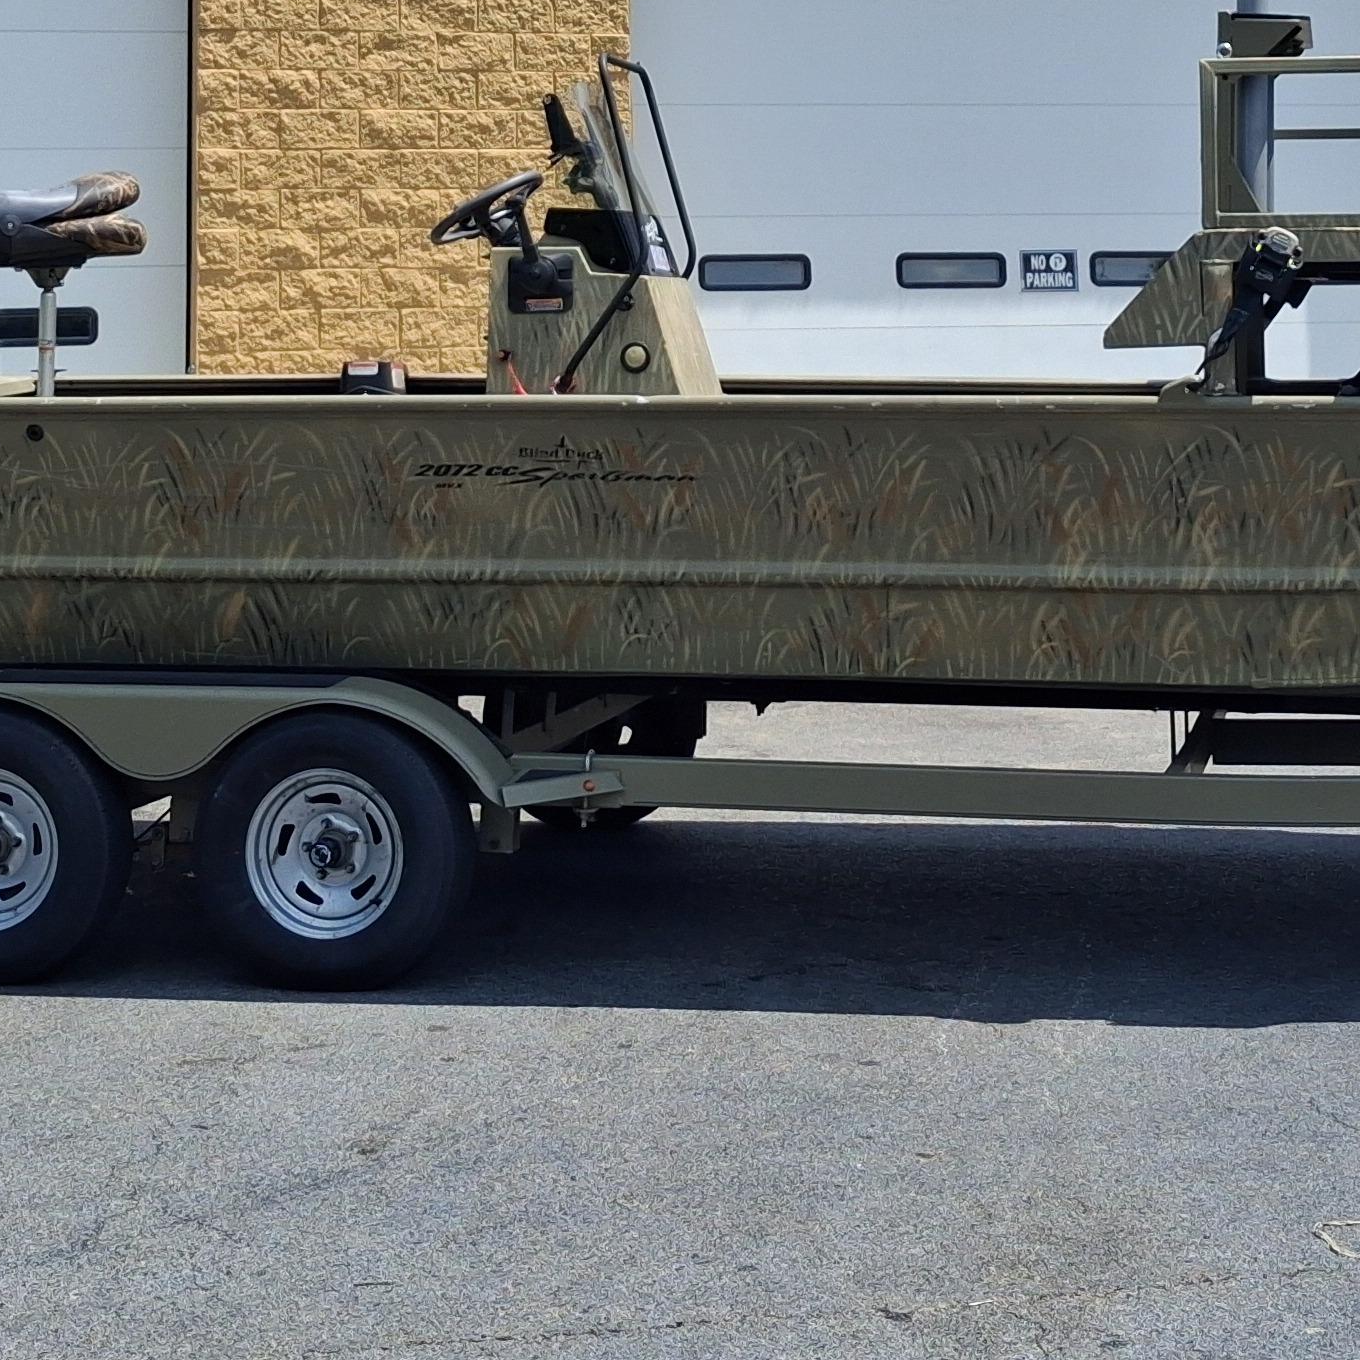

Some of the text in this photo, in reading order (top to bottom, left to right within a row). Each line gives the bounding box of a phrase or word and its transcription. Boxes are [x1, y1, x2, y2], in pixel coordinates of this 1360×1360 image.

[1030, 254, 1047, 271] NO
[1025, 272, 1074, 288] PARKING
[414, 463, 484, 477] 2072
